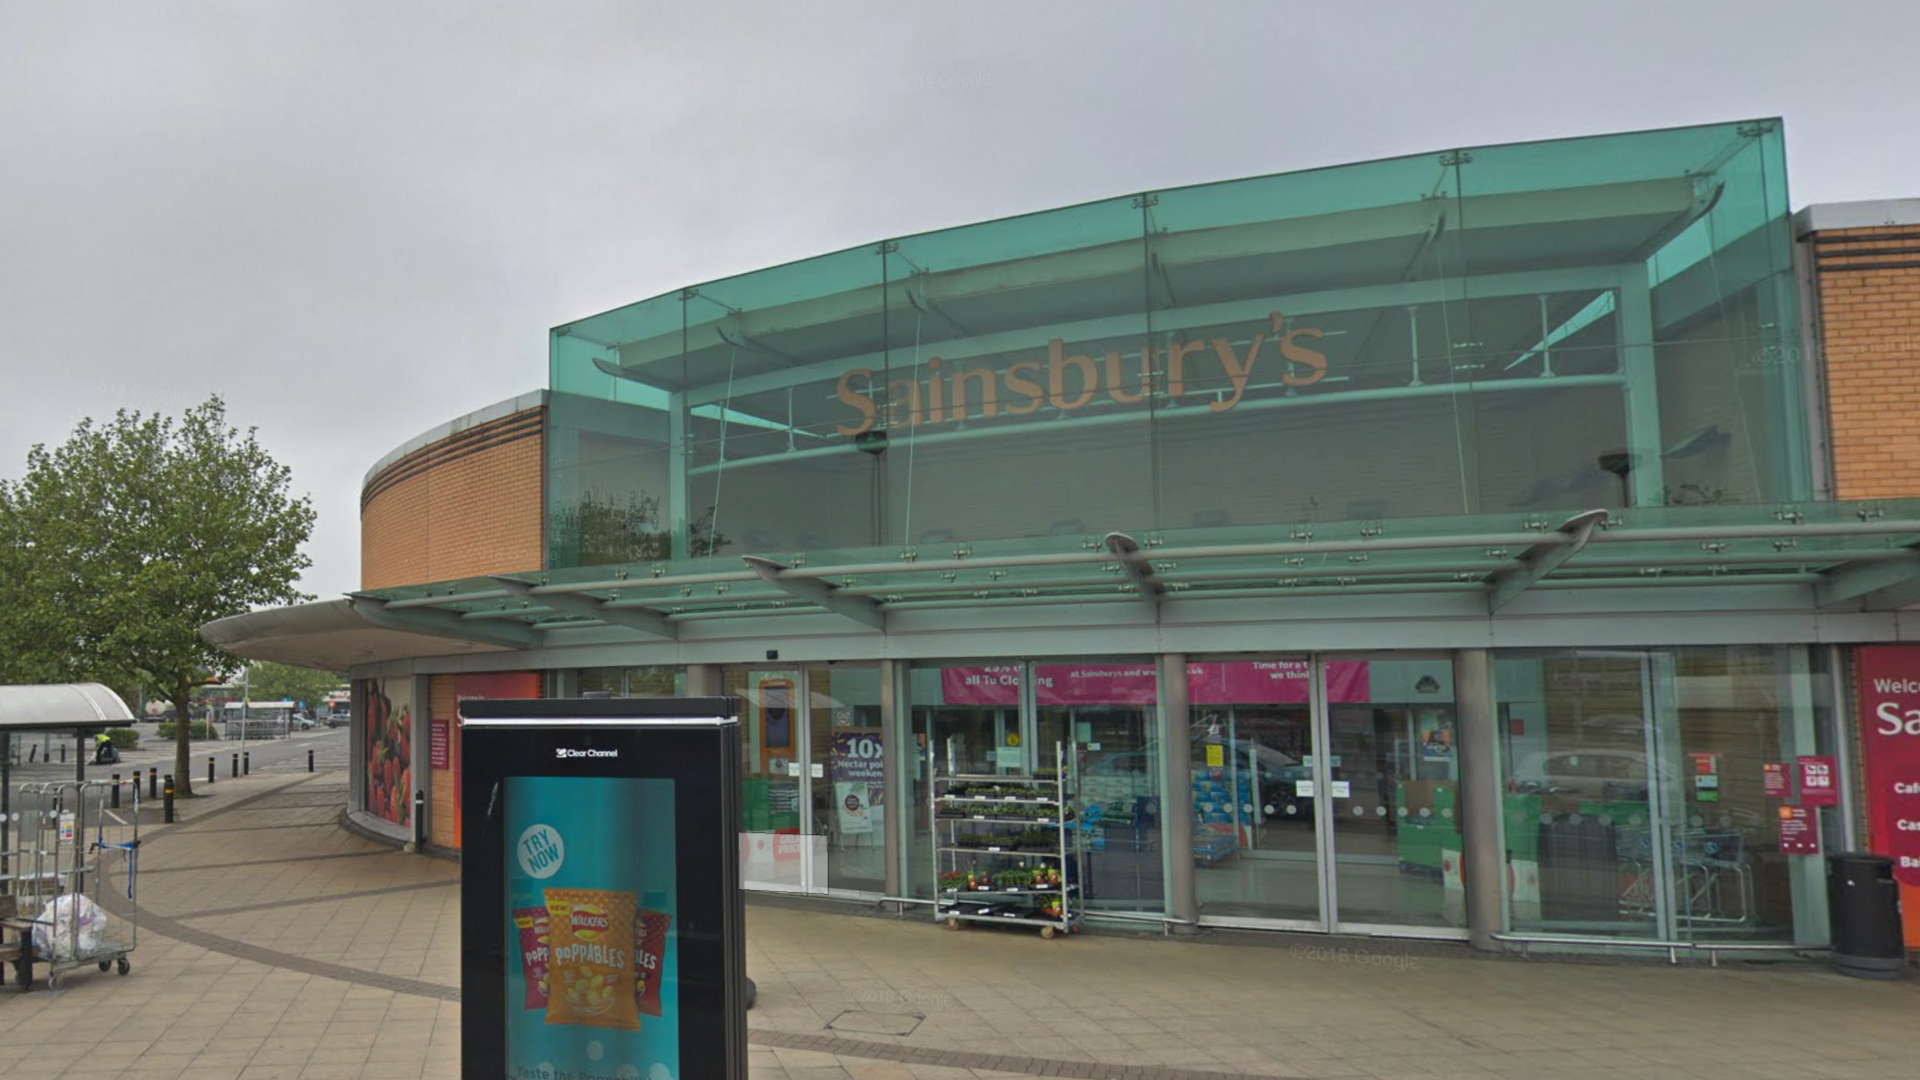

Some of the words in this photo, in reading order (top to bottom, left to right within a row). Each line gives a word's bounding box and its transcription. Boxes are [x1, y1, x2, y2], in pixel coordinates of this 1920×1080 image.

[836, 311, 1329, 437] Sainsbury's
[1253, 661, 1276, 669] Time
[1278, 661, 1293, 669] for
[965, 675, 980, 685] all
[983, 675, 997, 685] Tu
[1123, 669, 1141, 677] and
[1873, 678, 1920, 694] Welc
[566, 748, 587, 757] Clear
[587, 748, 618, 757] Channel
[837, 760, 868, 768] Nectar
[522, 828, 550, 856] TRY
[528, 843, 560, 874] NOW
[570, 914, 609, 928] WALKERS
[515, 1066, 550, 1078] Taste
[553, 1066, 574, 1080] the
